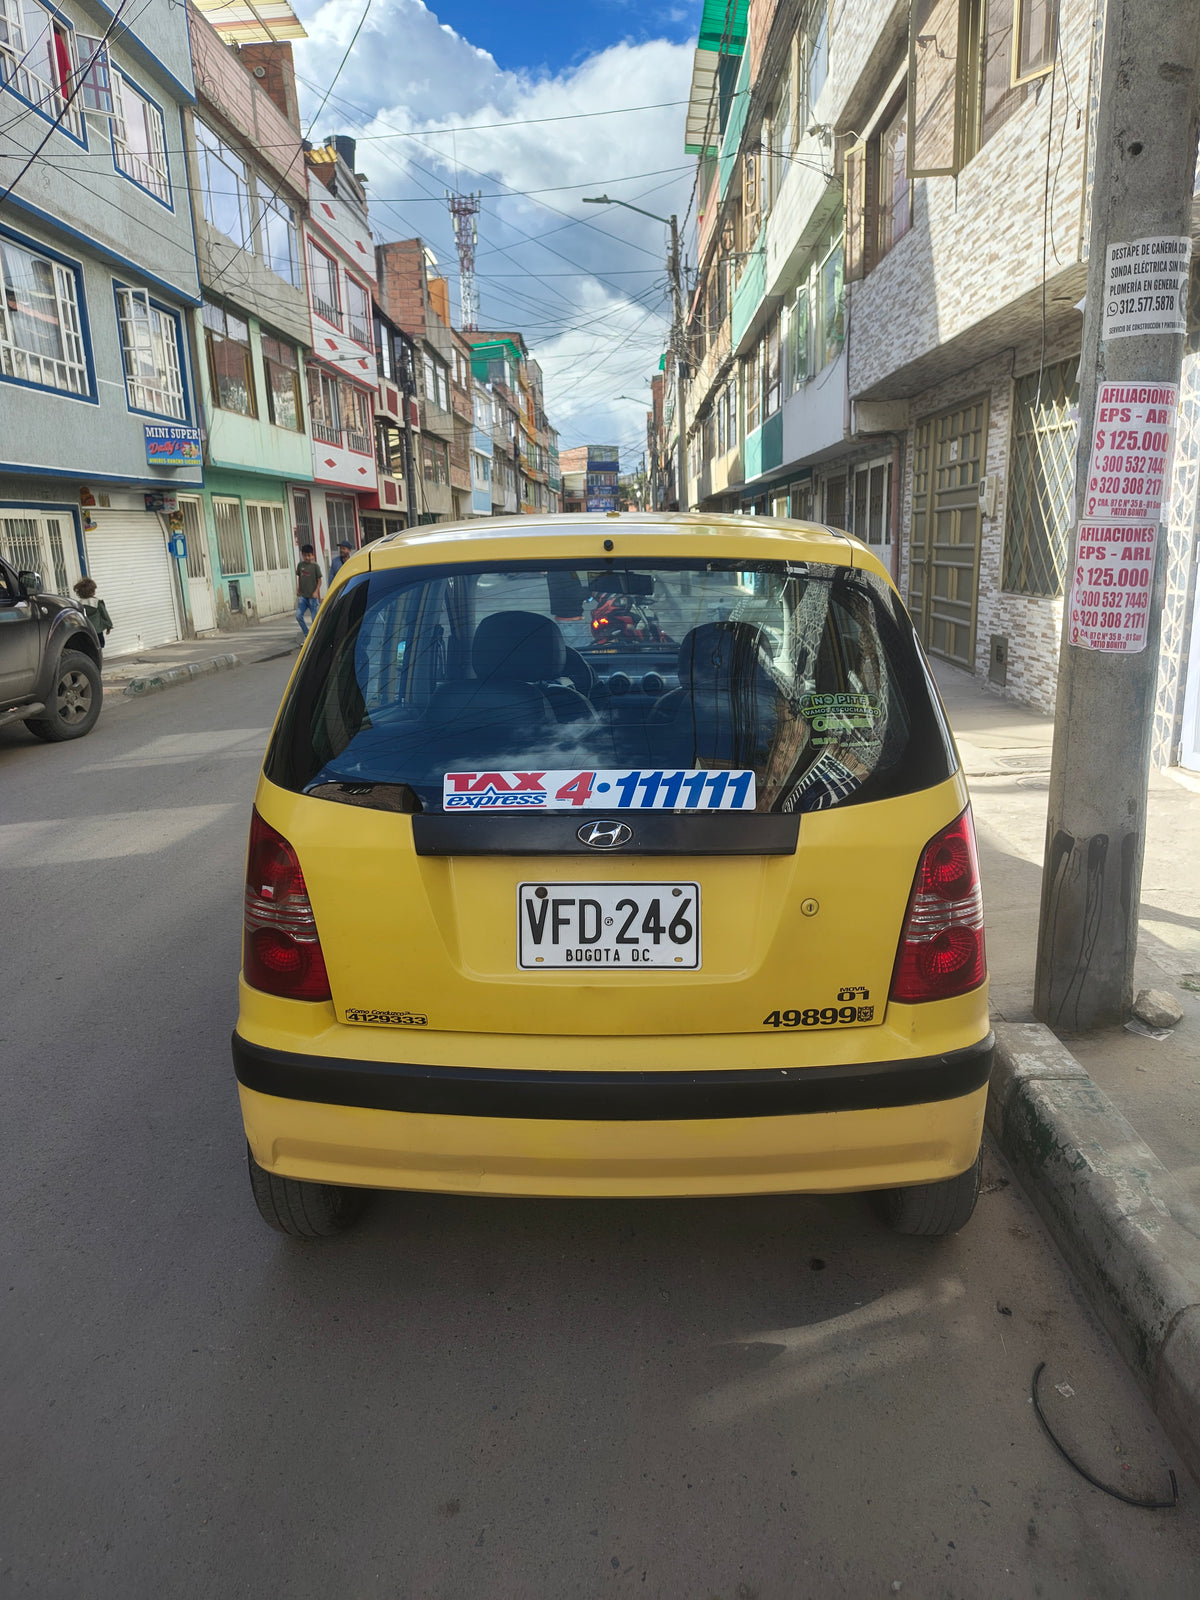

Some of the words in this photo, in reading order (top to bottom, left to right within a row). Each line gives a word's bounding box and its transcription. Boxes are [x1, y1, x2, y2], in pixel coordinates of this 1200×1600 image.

[1111, 245, 1140, 261] DESTAPE
[1141, 244, 1150, 256] DE
[1151, 240, 1178, 255] CAÑERÍA
[1110, 266, 1132, 279] SONDA
[1133, 261, 1168, 275] ELÉCTRICA
[1168, 262, 1178, 272] SIN
[1109, 281, 1142, 296] PLOMERÍA
[1143, 281, 1153, 291] EN
[1153, 279, 1180, 291] GENERAL
[1119, 296, 1175, 315] 312.577.5878
[1126, 324, 1132, 332] DE
[1101, 388, 1175, 406] AFILIACIONES
[1099, 408, 1132, 423] EPS
[145, 427, 170, 439] MINI
[170, 428, 199, 440] SUPER
[1095, 429, 1106, 451] $
[1109, 430, 1170, 452] 125.000
[1102, 455, 1124, 472] 300
[1125, 455, 1147, 473] 532
[1099, 476, 1121, 494] 320
[1122, 477, 1145, 494] 308
[1145, 478, 1163, 496] 217
[1110, 507, 1127, 516] PATIO
[1080, 527, 1154, 543] AFILIACIONES
[1079, 545, 1107, 560] EPS
[1121, 546, 1152, 561] ARL
[1087, 567, 1149, 587] 125.000
[1081, 590, 1100, 607] 300
[1102, 591, 1123, 608] 532
[1124, 591, 1148, 609] 7443
[1080, 610, 1098, 627] 320
[1100, 611, 1122, 628] 308
[1124, 612, 1146, 629] 2171
[1106, 640, 1127, 649] BONITO
[814, 695, 834, 705] NO
[837, 695, 866, 704] PITE
[805, 708, 830, 716] VAMOS
[446, 772, 547, 792] TAX
[446, 793, 547, 808] express
[525, 898, 603, 945] VFD
[615, 898, 693, 945] 246
[565, 949, 621, 963] BOGOTA
[631, 949, 654, 963] D.C.
[837, 990, 870, 1002] 01
[348, 1013, 427, 1025] 4129333
[763, 1006, 857, 1028] 49899
